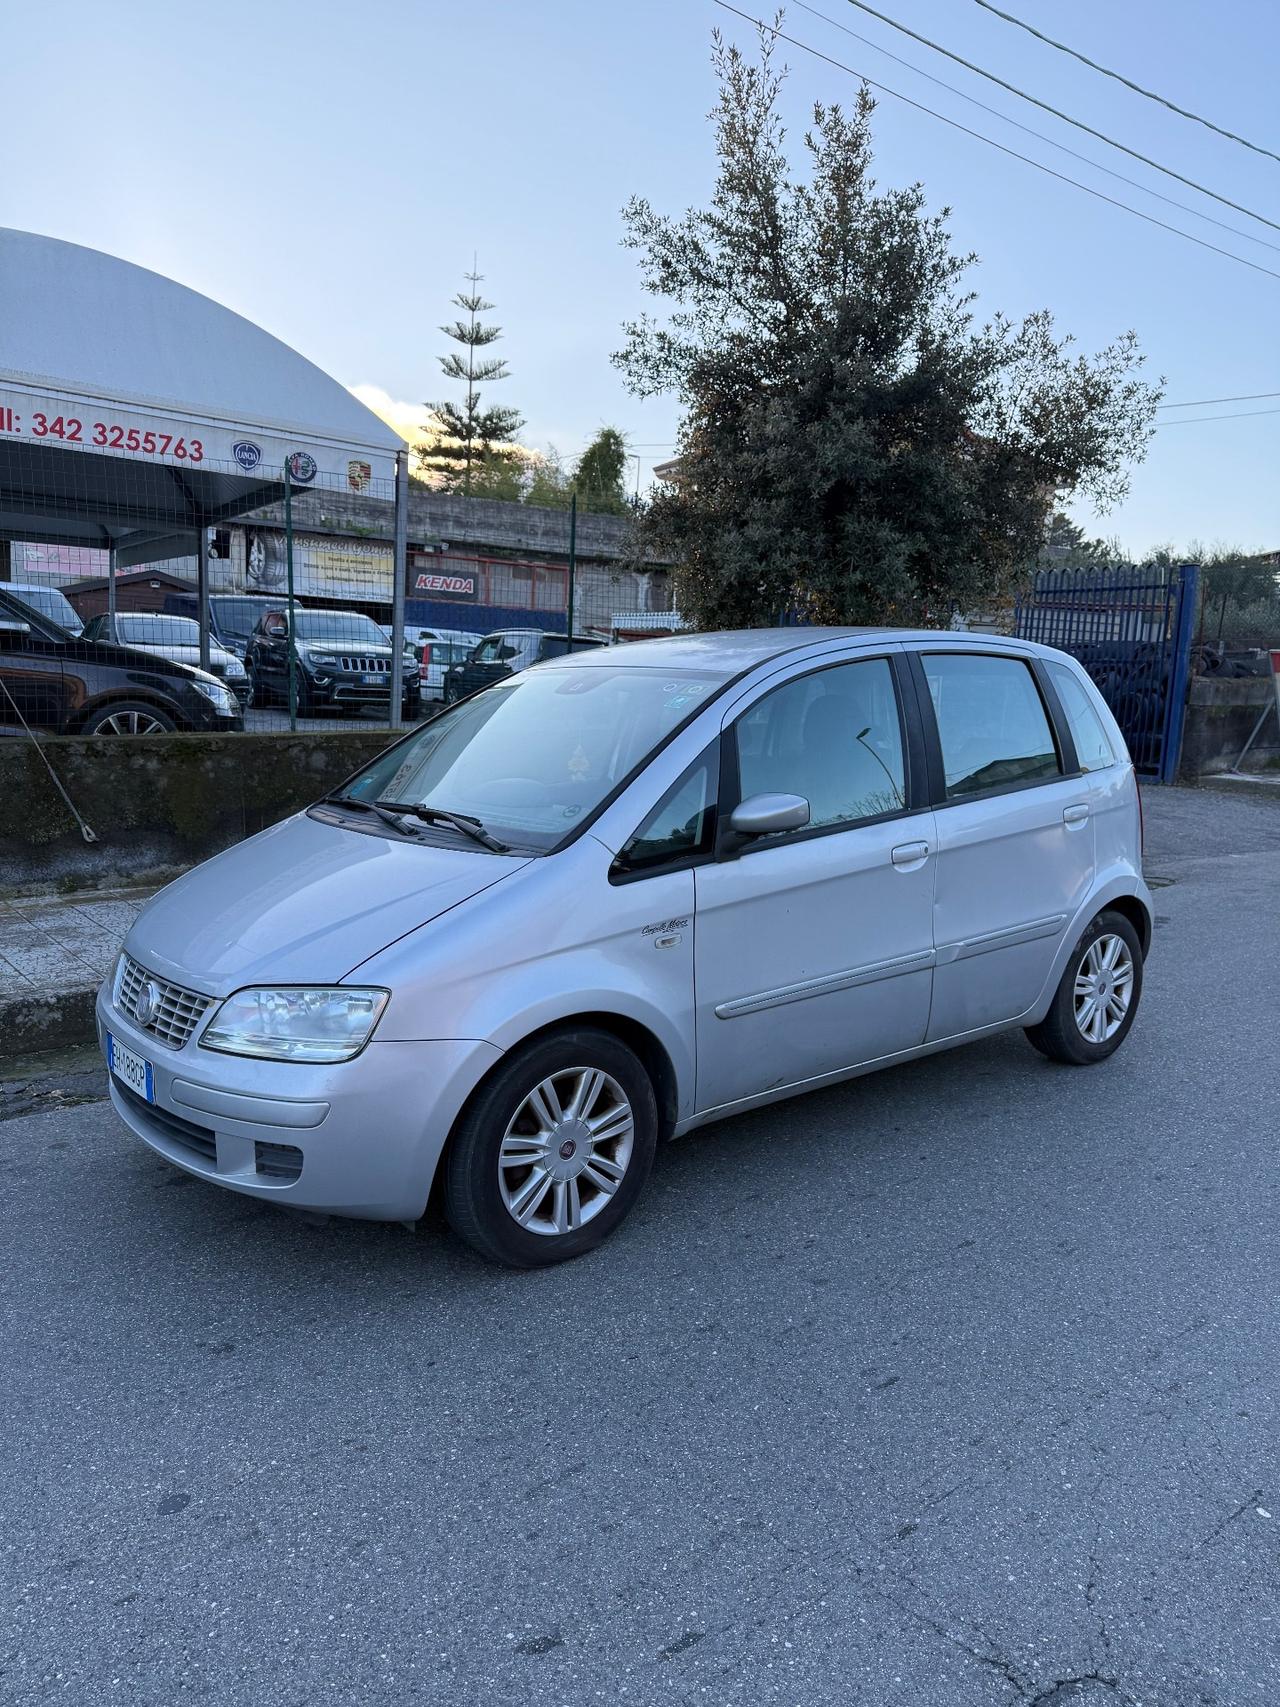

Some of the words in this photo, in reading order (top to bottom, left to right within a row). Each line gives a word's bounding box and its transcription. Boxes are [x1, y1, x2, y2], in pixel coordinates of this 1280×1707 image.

[32, 413, 82, 441] 342
[92, 422, 204, 462] 3255763
[415, 574, 474, 593] KENDA
